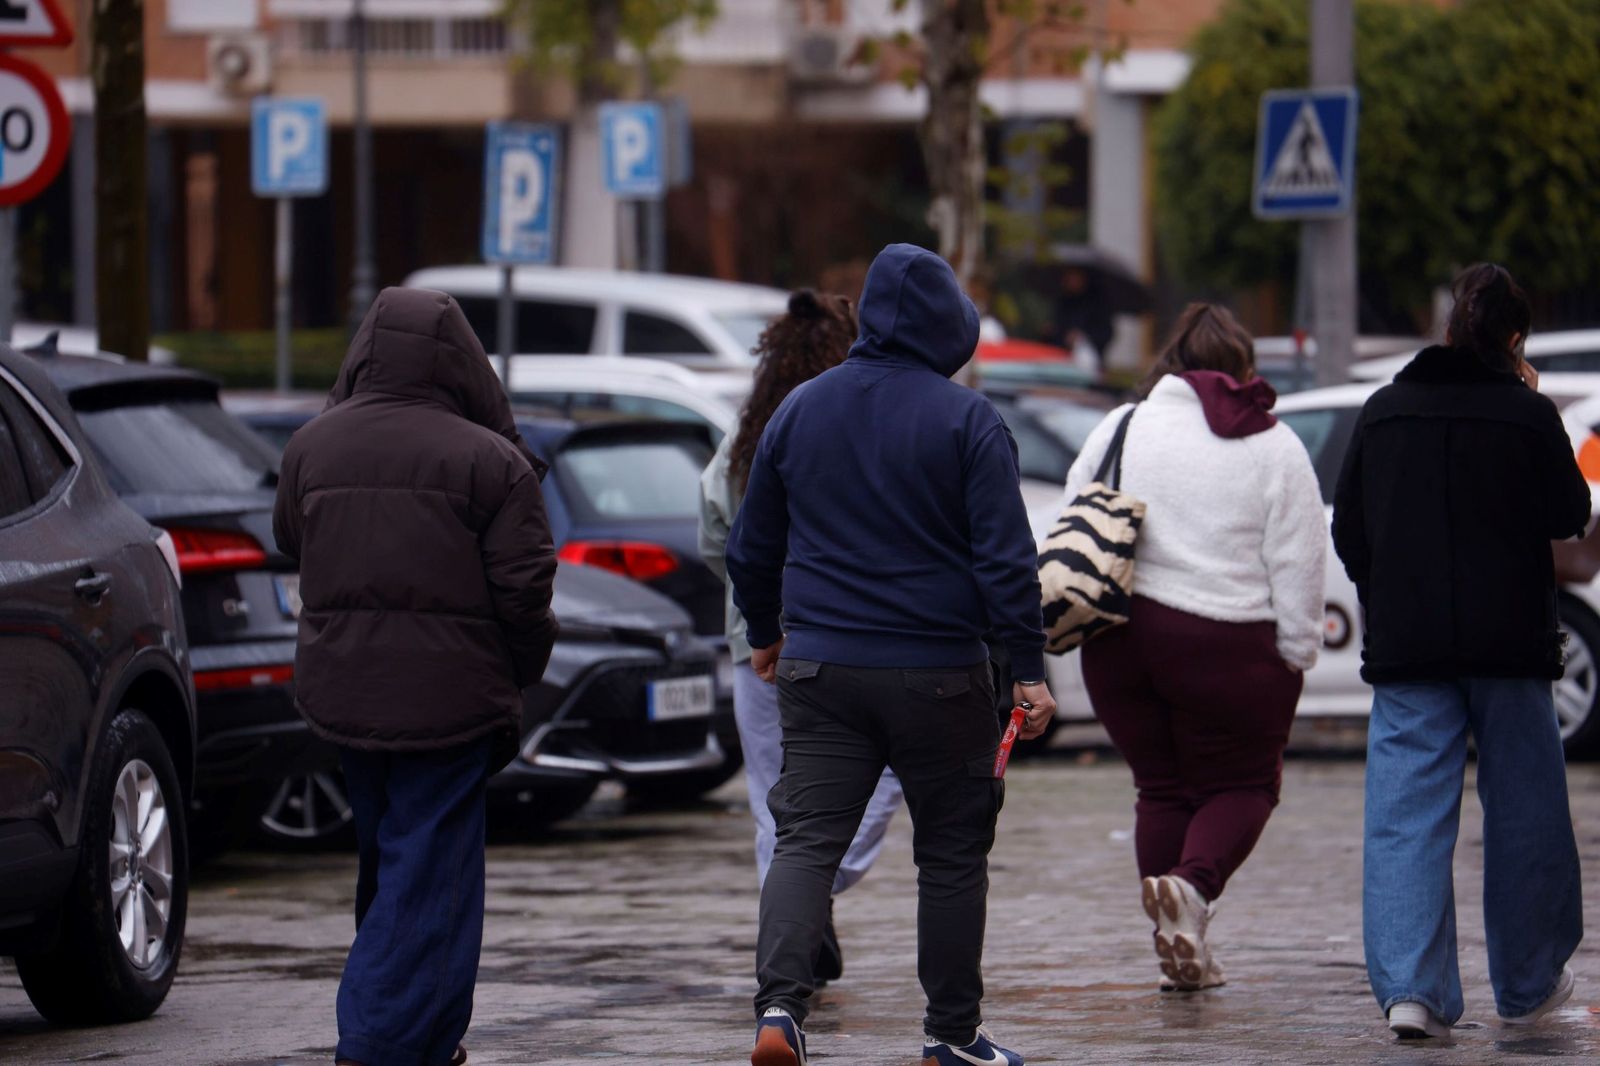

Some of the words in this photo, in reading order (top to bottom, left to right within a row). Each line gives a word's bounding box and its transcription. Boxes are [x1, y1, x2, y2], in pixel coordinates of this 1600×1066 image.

[268, 110, 309, 179] P
[613, 117, 647, 180] P
[499, 151, 544, 255] P
[767, 1007, 784, 1015] NIKE
